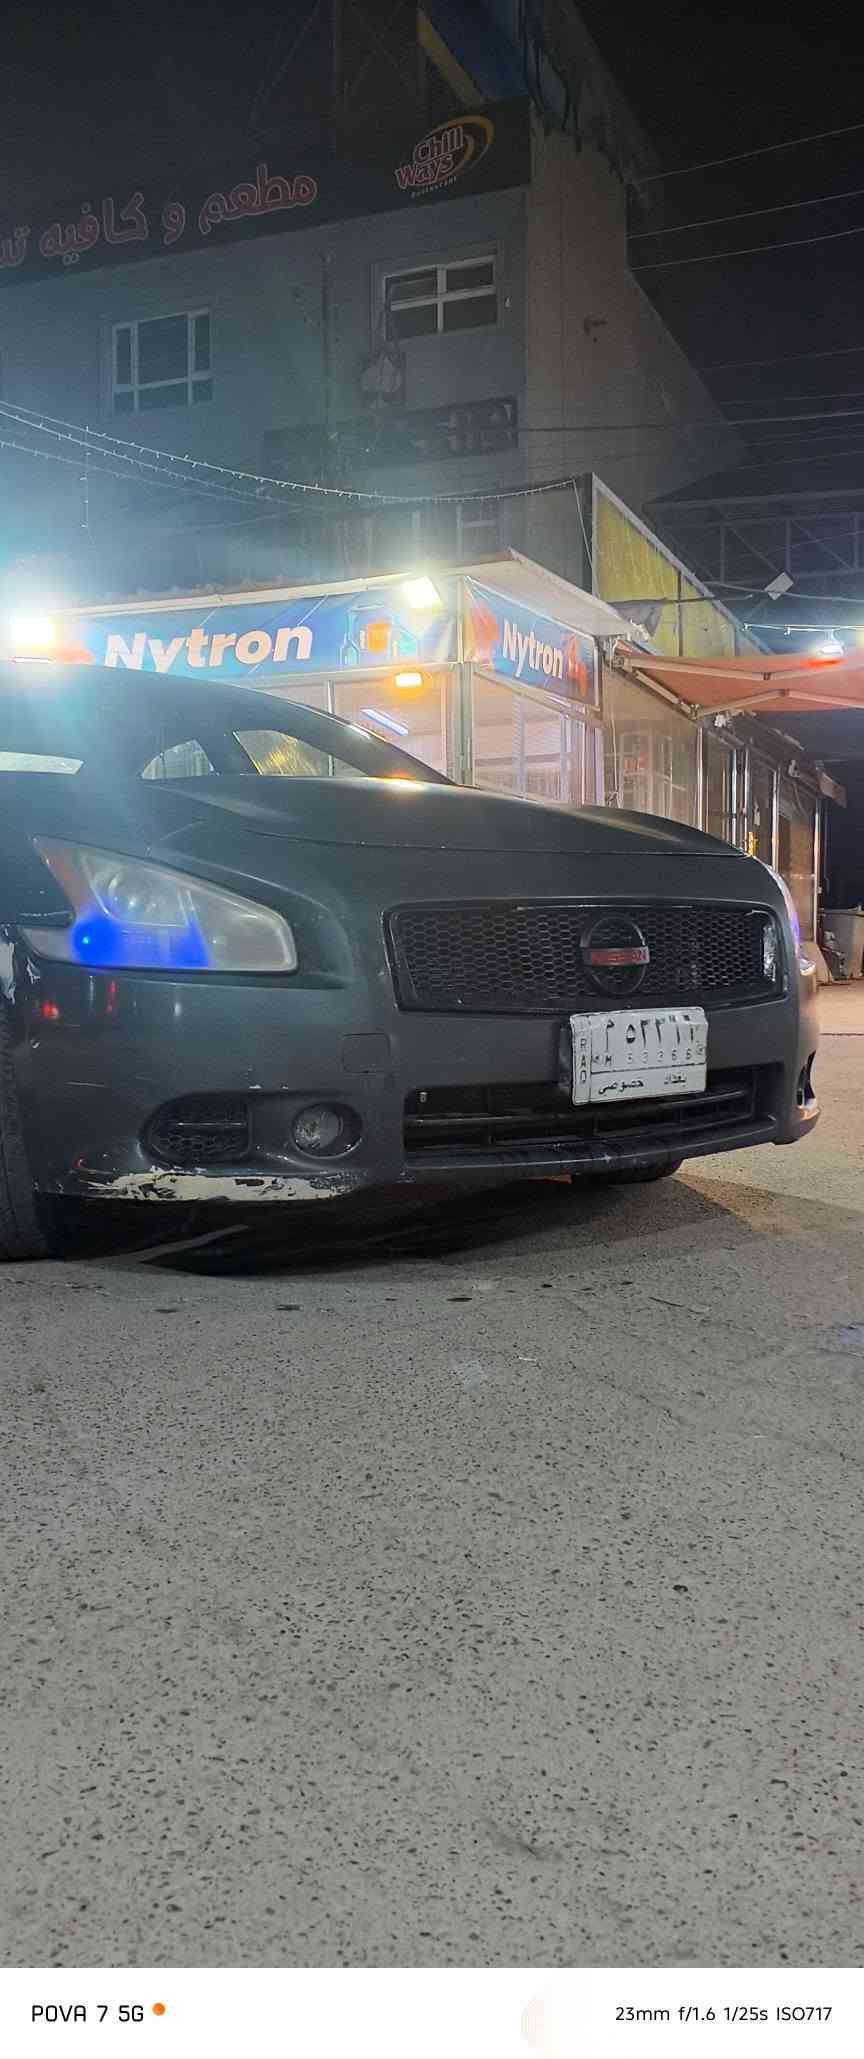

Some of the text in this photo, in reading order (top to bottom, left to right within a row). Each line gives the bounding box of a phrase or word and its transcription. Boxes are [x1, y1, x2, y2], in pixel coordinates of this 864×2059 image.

[40, 192, 149, 266] كافيه
[162, 201, 186, 246] و
[199, 163, 318, 235] مطعم
[103, 625, 313, 673] Nytron
[502, 618, 563, 680] Nytron
